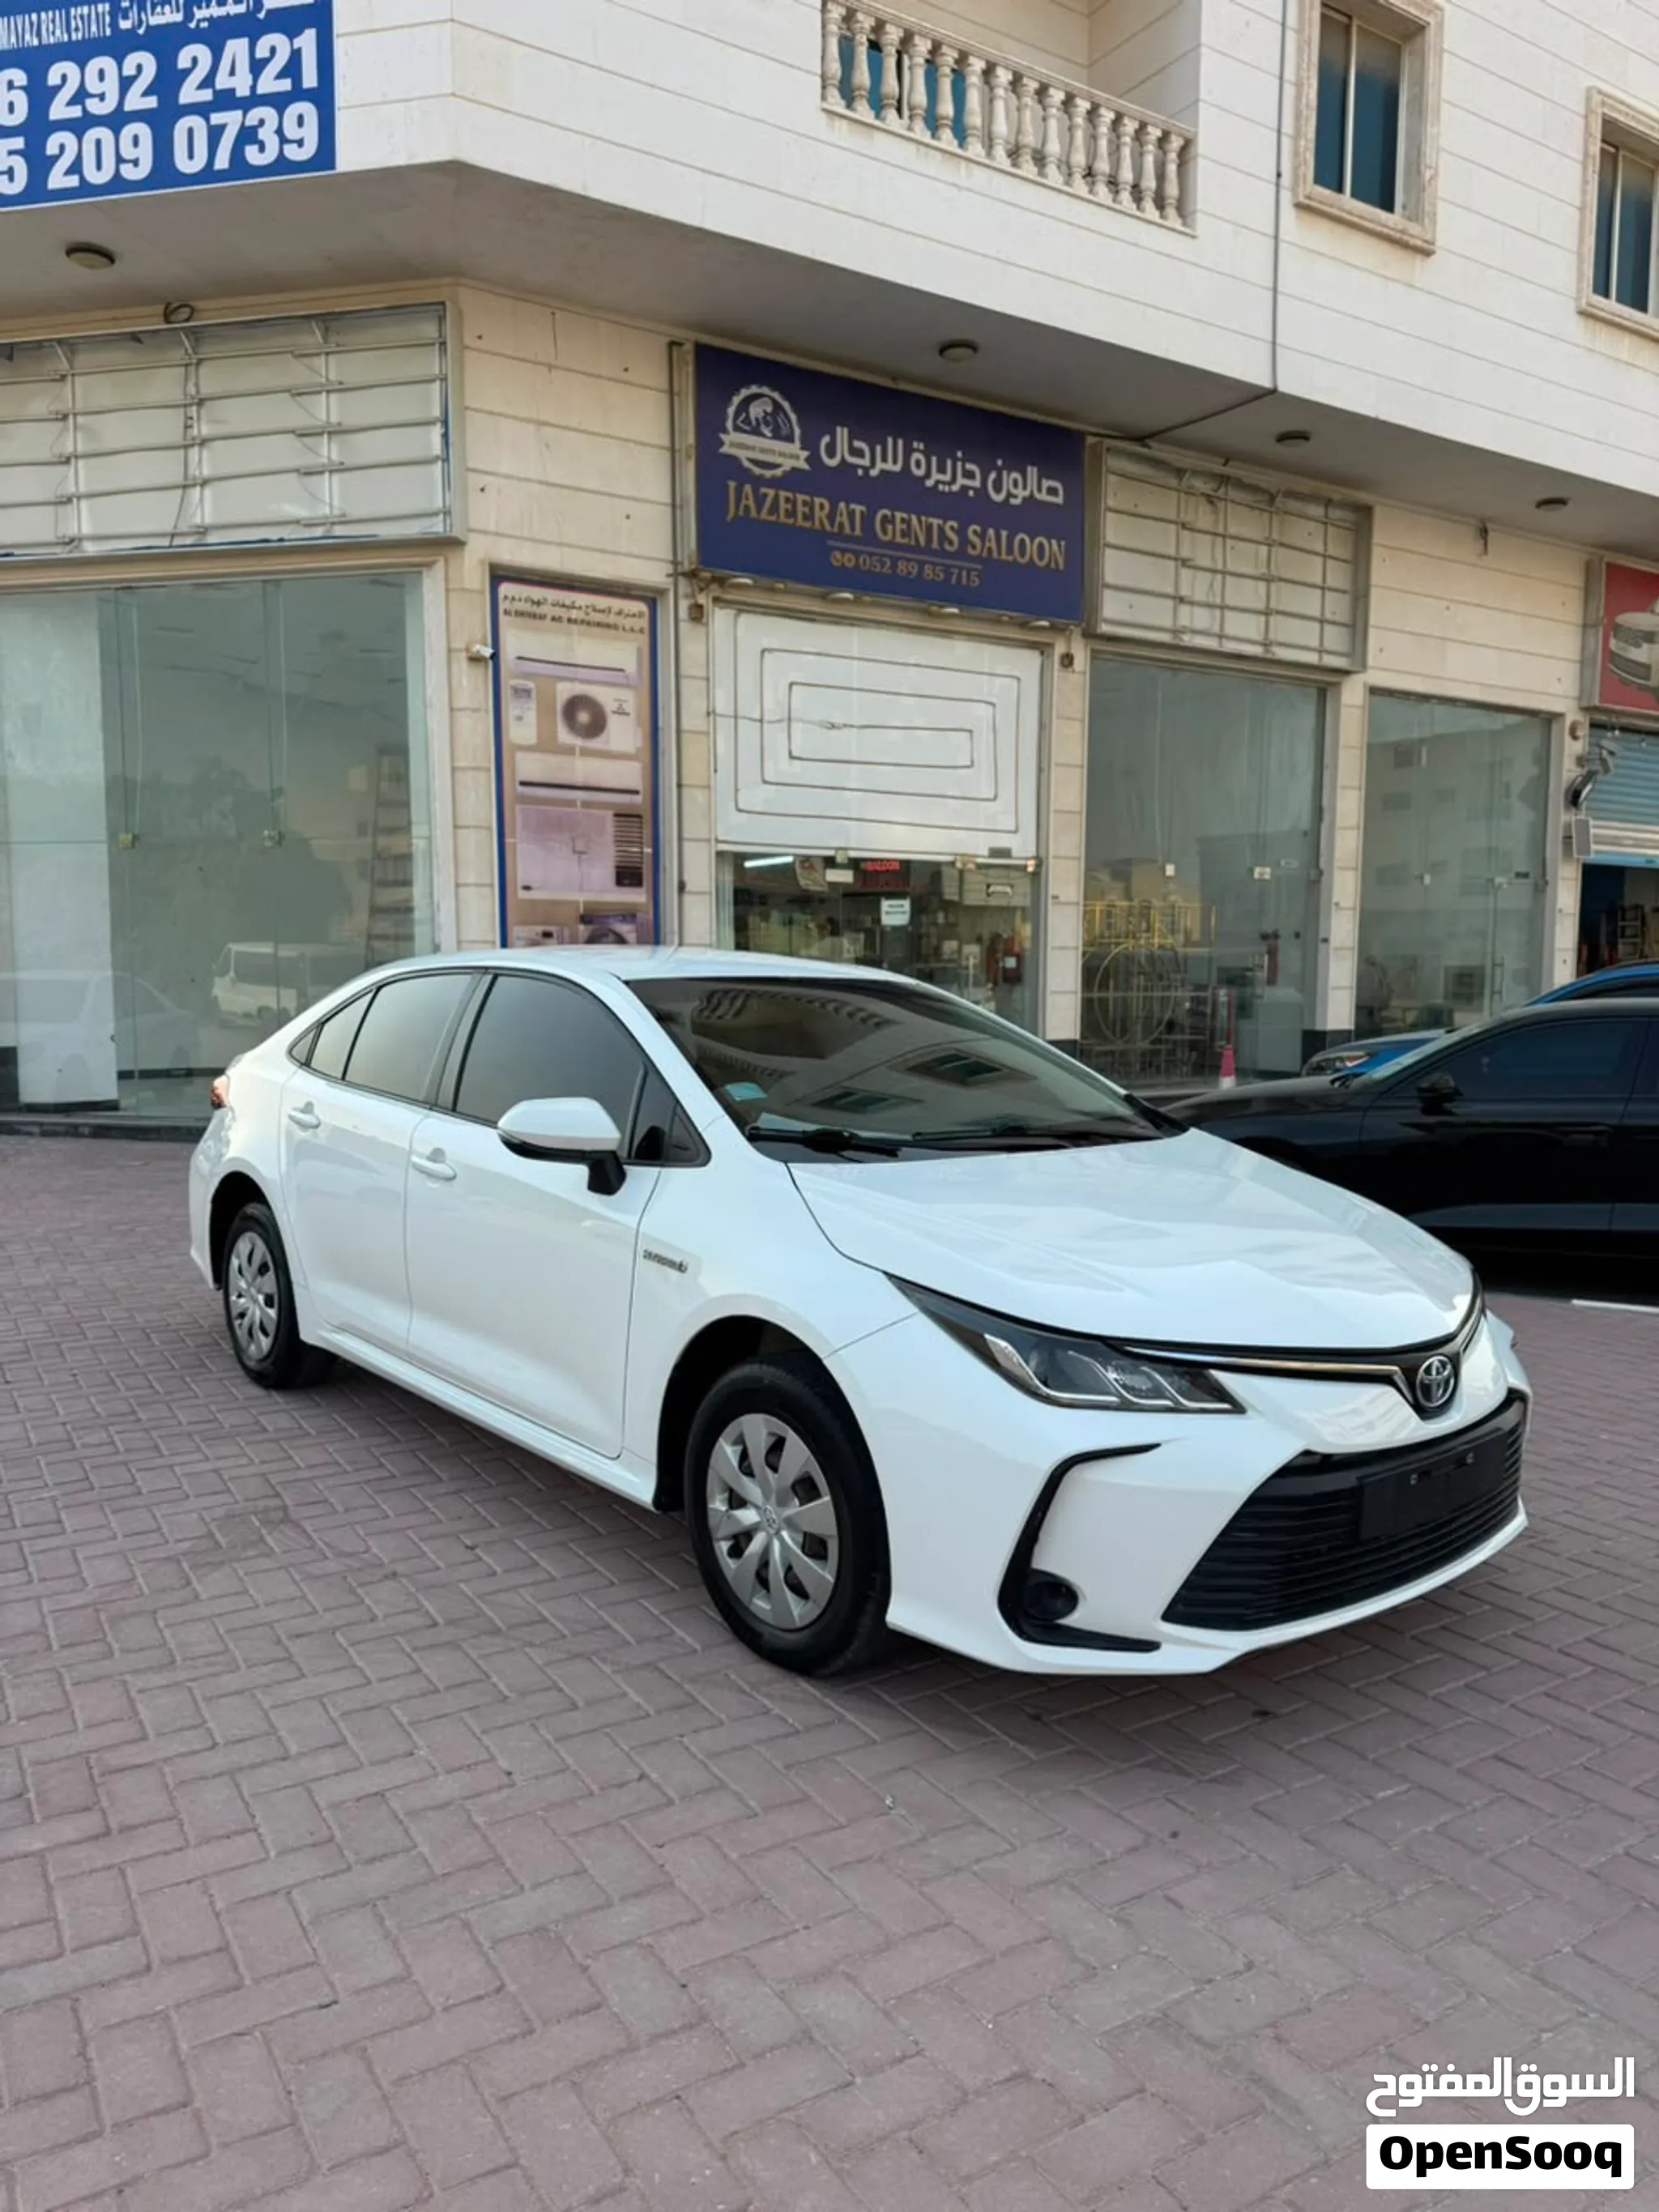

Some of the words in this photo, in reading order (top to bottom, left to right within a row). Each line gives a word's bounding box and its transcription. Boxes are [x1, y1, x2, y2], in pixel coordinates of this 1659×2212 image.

[41, 8, 69, 45] REAL
[70, 2, 112, 41] ESTATE
[0, 68, 28, 126] 6
[47, 50, 158, 121] 292
[177, 28, 318, 104] 2421
[0, 136, 28, 195] 5
[45, 121, 153, 190] 209
[173, 101, 319, 174] 0739
[820, 425, 904, 476] للرجال
[910, 441, 982, 497] جزيرة
[987, 458, 1064, 505] صالون
[726, 480, 867, 537] JAZEERAT
[875, 508, 959, 552] GENTS
[966, 523, 1066, 570] SALOON
[859, 554, 891, 573] 052
[897, 559, 919, 578] 89
[949, 569, 981, 587] 715
